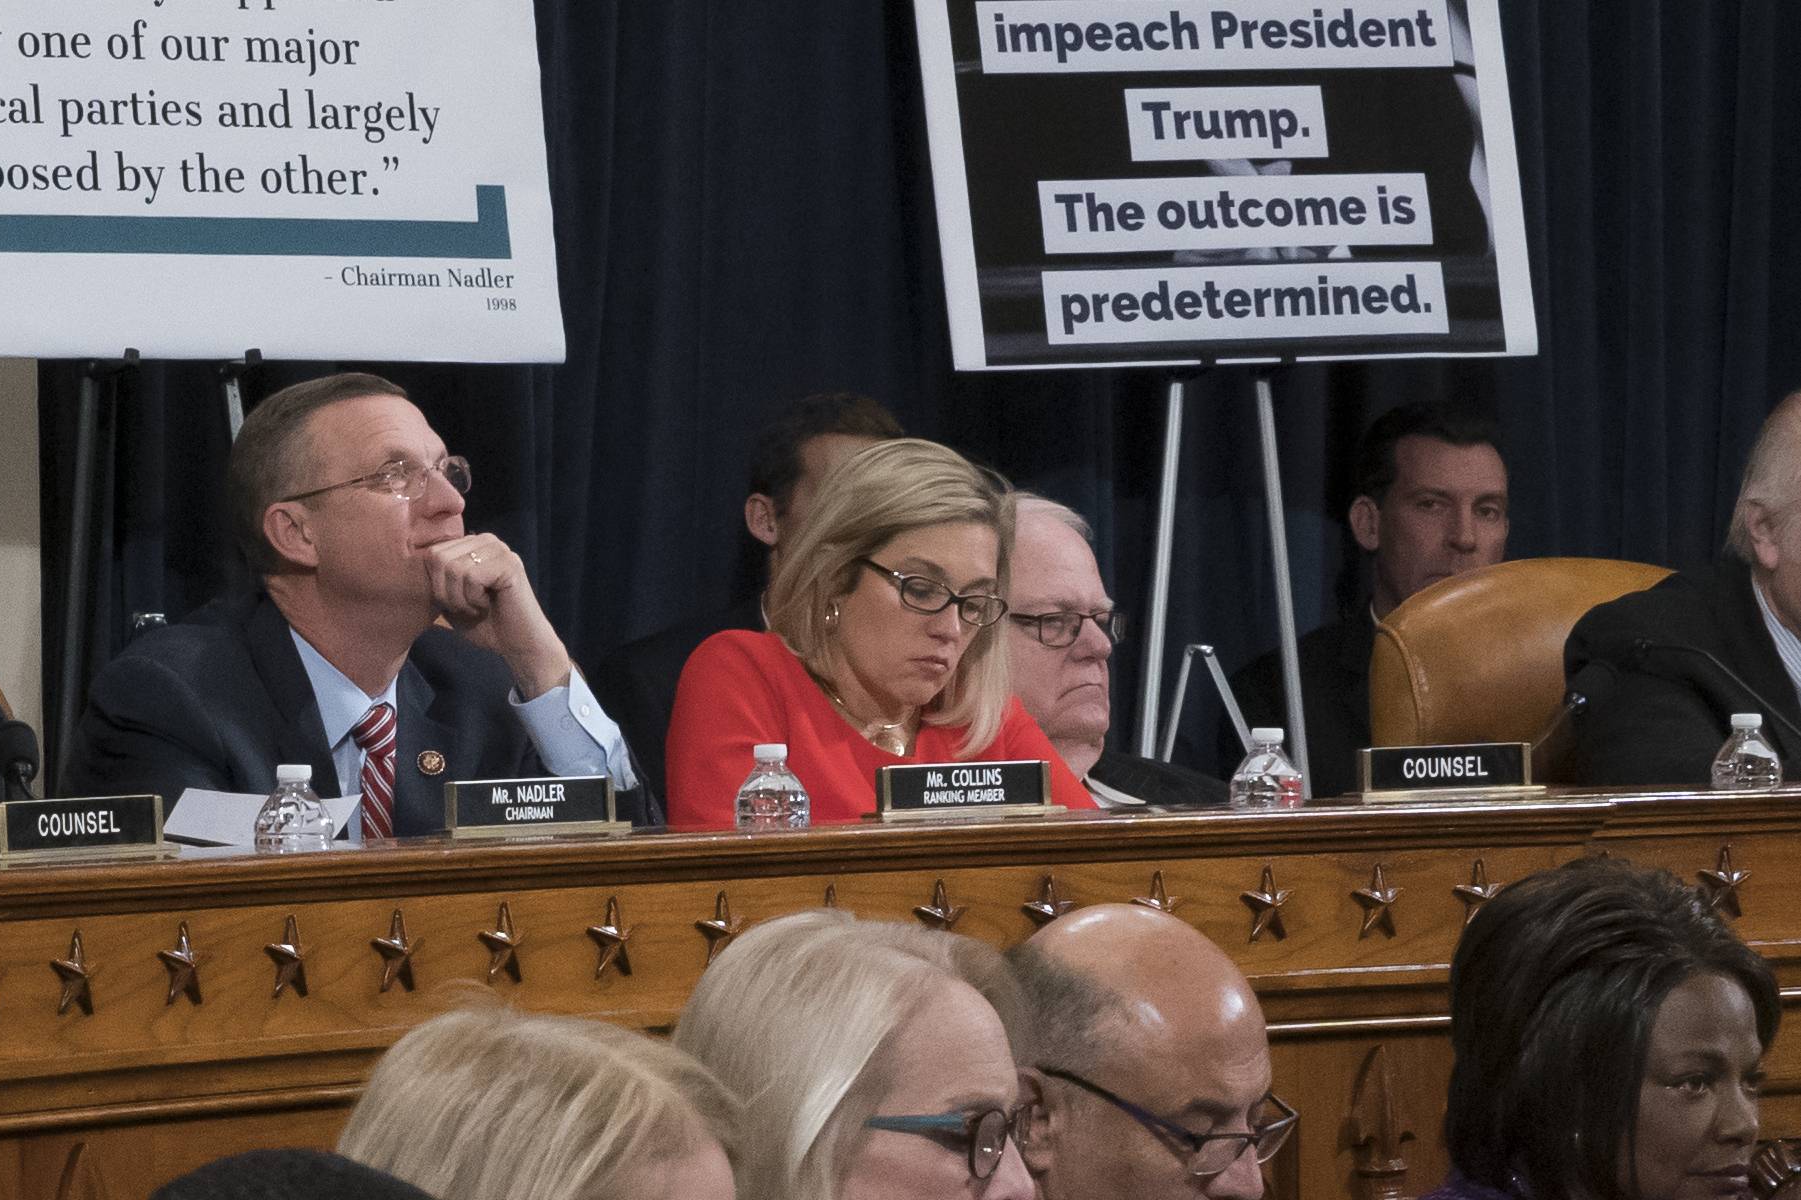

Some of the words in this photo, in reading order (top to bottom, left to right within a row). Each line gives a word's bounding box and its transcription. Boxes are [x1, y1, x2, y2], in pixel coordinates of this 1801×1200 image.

[18, 32, 91, 60] one
[107, 19, 148, 60] of
[161, 35, 230, 62] our
[243, 28, 360, 76] major
[994, 11, 1200, 63] impeach
[1210, 8, 1438, 52] President
[57, 89, 203, 137] parties
[218, 88, 293, 130] and
[304, 89, 441, 144] largely
[1141, 100, 1311, 149] Trump.
[115, 151, 165, 205] by
[179, 153, 246, 195] the
[1054, 191, 1146, 233] The
[1157, 190, 1368, 230] outcome
[1377, 186, 1416, 225] is
[341, 265, 441, 288] Chairman
[447, 267, 515, 290] Nadler
[486, 298, 517, 312] 1998
[1061, 274, 1432, 334] predetermined.
[951, 768, 1003, 786] COLLINS
[1403, 755, 1489, 779] COUNSEL
[516, 783, 566, 803] NADLER
[923, 789, 966, 804] RANKING
[966, 788, 1006, 803] MEMBER
[37, 810, 121, 837] COUNSEL
[505, 806, 554, 821] CHAIRMAN
